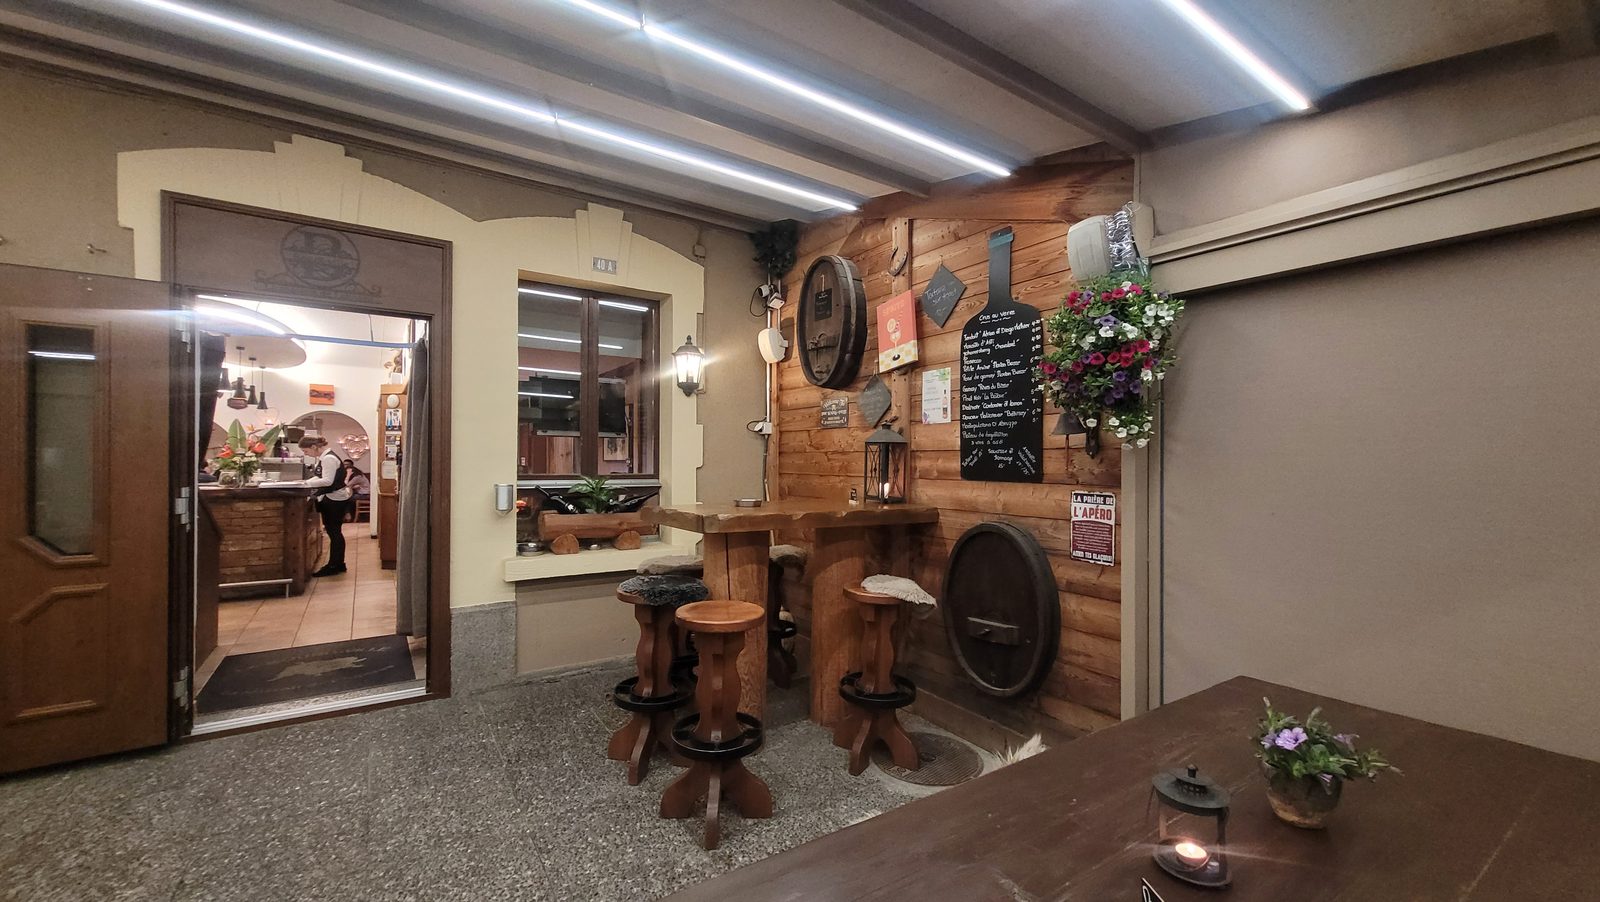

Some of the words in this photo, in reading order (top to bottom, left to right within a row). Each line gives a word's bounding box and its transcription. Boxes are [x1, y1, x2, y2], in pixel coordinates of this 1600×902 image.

[596, 258, 605, 270] 40
[608, 260, 612, 272] A
[1084, 495, 1103, 504] PRIÈRE
[1074, 505, 1112, 520] L'APÉRO
